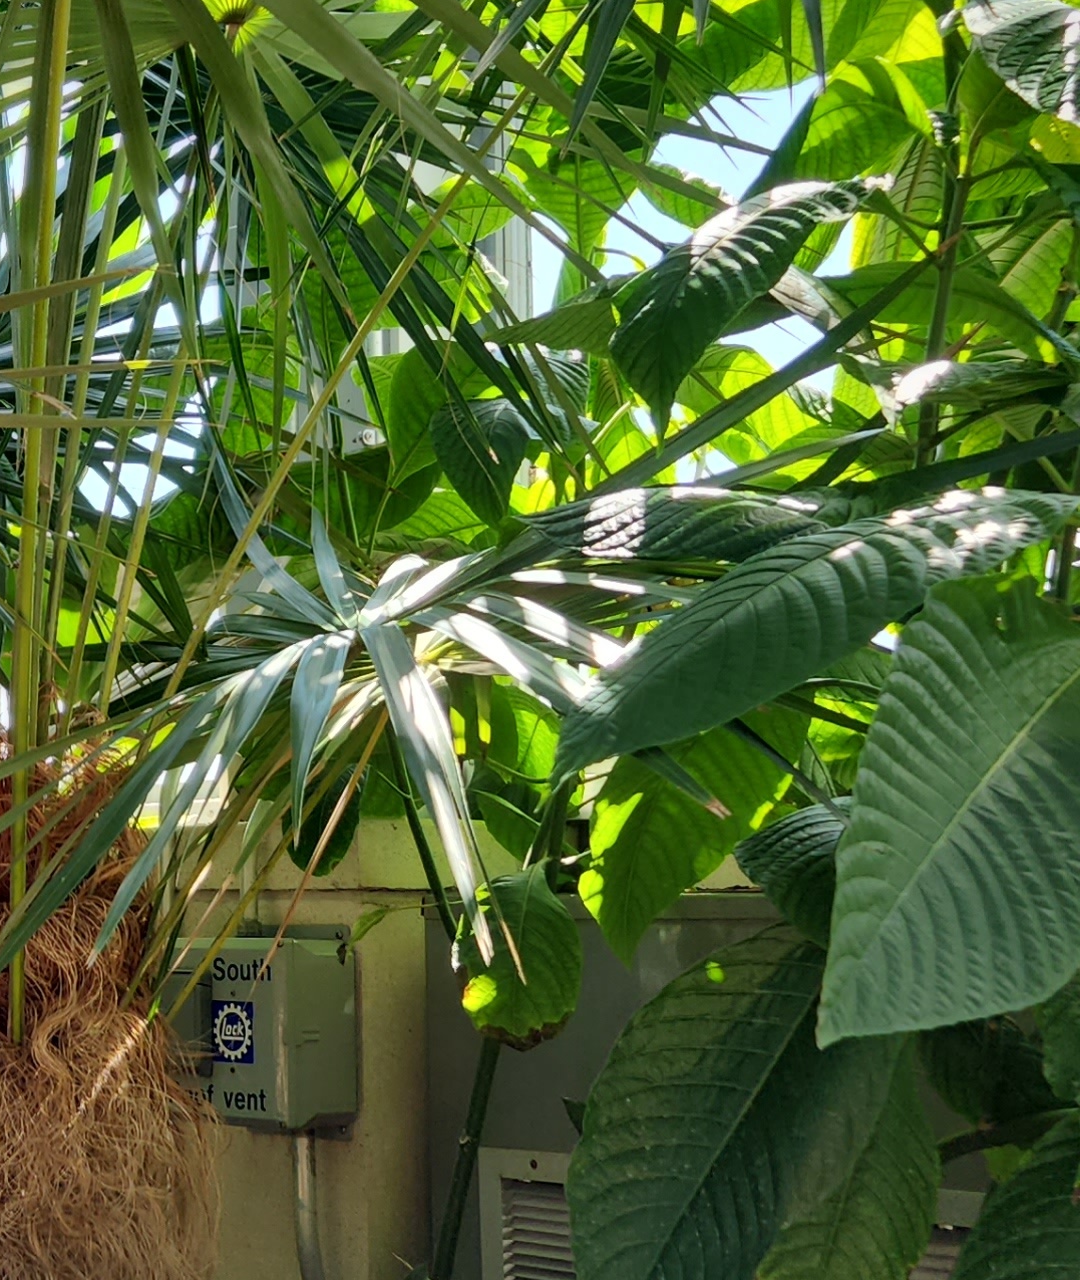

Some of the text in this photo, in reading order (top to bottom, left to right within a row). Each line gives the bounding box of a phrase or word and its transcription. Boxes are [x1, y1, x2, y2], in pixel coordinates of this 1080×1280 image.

[213, 957, 271, 981] South
[222, 1018, 245, 1040] Lock
[223, 1089, 266, 1112] vent
